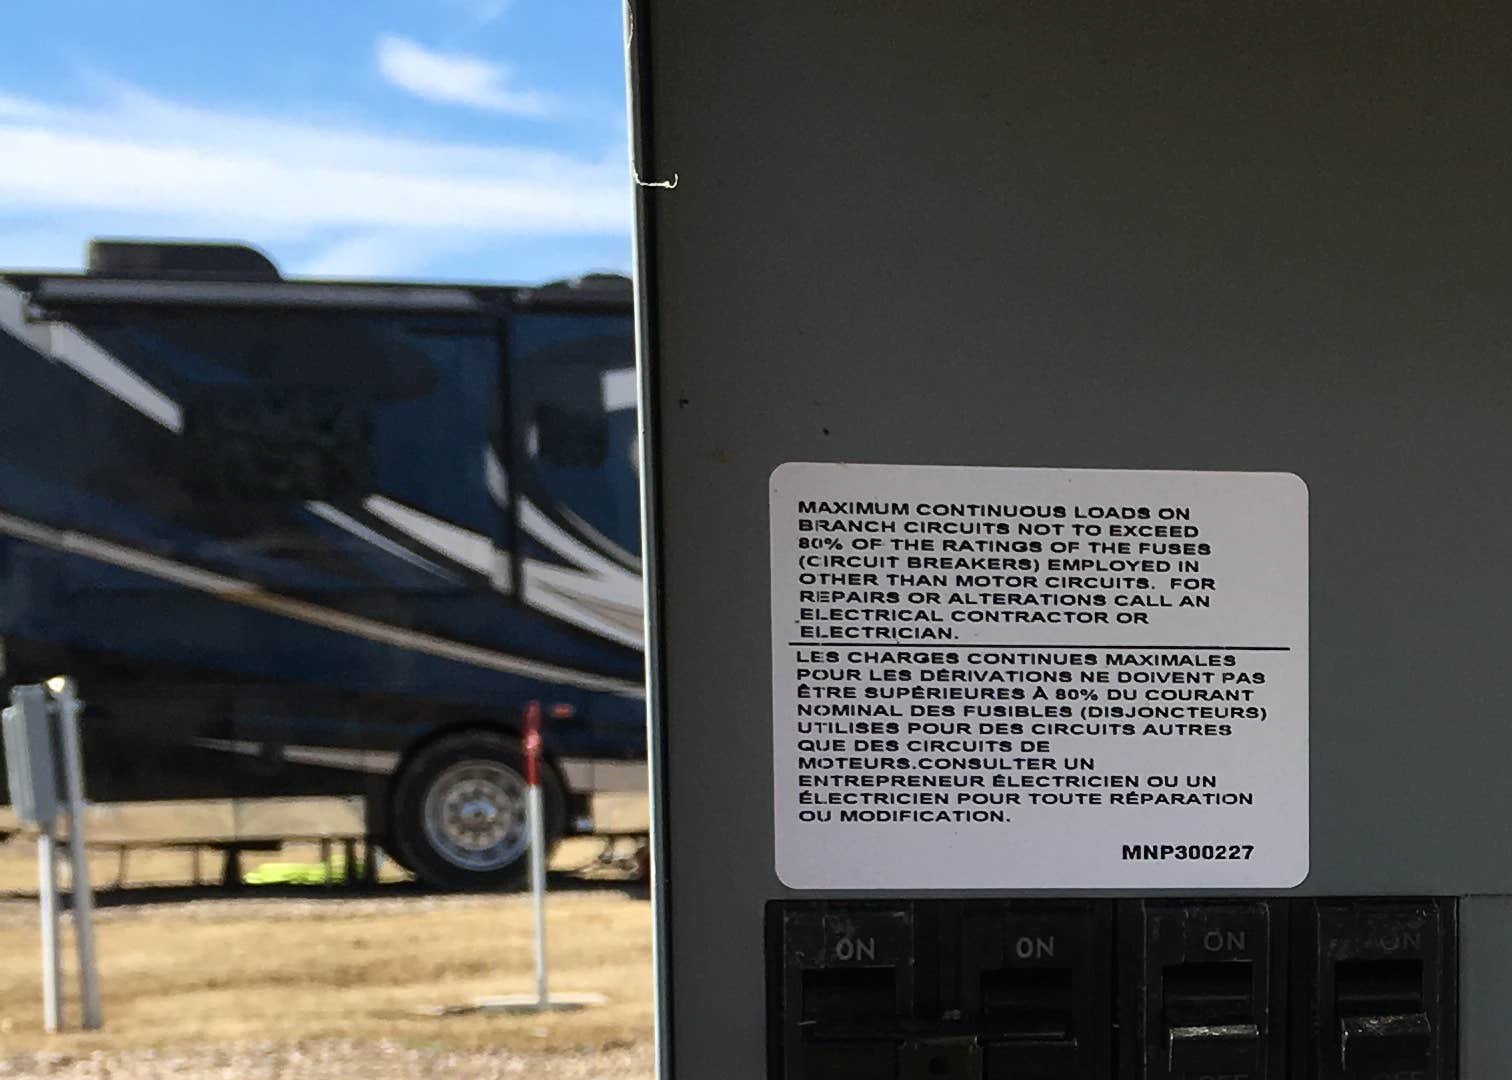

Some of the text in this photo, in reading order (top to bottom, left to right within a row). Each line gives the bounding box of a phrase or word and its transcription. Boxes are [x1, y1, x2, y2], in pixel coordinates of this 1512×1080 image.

[797, 500, 1190, 521] MAXIMUM CONTINUOUS LOADS ON
[798, 518, 1199, 539] BRANCH CIRCUITS NOT TO EXCEED
[798, 536, 1212, 556] 80% OF THE RATINGS OF THE FUSES
[798, 554, 1200, 574] (CIRCUIT BREAKERS) EMPLOYED IN
[798, 572, 1217, 592] OTHER THAN MOTOR CIRCUITS. FOR
[799, 589, 1210, 608] REPAIRS OR ALTERATIONS CALL AN
[799, 607, 1150, 625] ELECTRICAL CONTRACTOR OR
[800, 625, 959, 642] ELECTRICIAN.
[796, 650, 1237, 669] LES CHARGES CONTINUES MAXIMALES
[796, 667, 1266, 685] POUR LES DÉRIVATIONS NE DOIVENT PAS
[797, 682, 1255, 702] ÊTRE SUPÉRIEURES À 80% DU COURANT
[797, 703, 1267, 722] NOMINAL DES FUSIBLES (DISJONCTEURS)
[797, 721, 1233, 737] UTILISES POUR DES CIRCUITS AUTRES
[797, 739, 1051, 753] QUE DES CIRCUITS DE
[1063, 757, 1095, 771] UN
[798, 773, 1217, 788] ENTREPRENEUR ÉLECTRICIEN OU UN
[798, 789, 1253, 806] ÉLECTRICIEN POUR TOUTE RÉPARATION
[798, 809, 1011, 823] OU MODIFICATION.
[1121, 844, 1255, 861] MNP300227
[836, 936, 875, 961] ON
[1015, 936, 1055, 959] ON
[1202, 931, 1246, 953] ON
